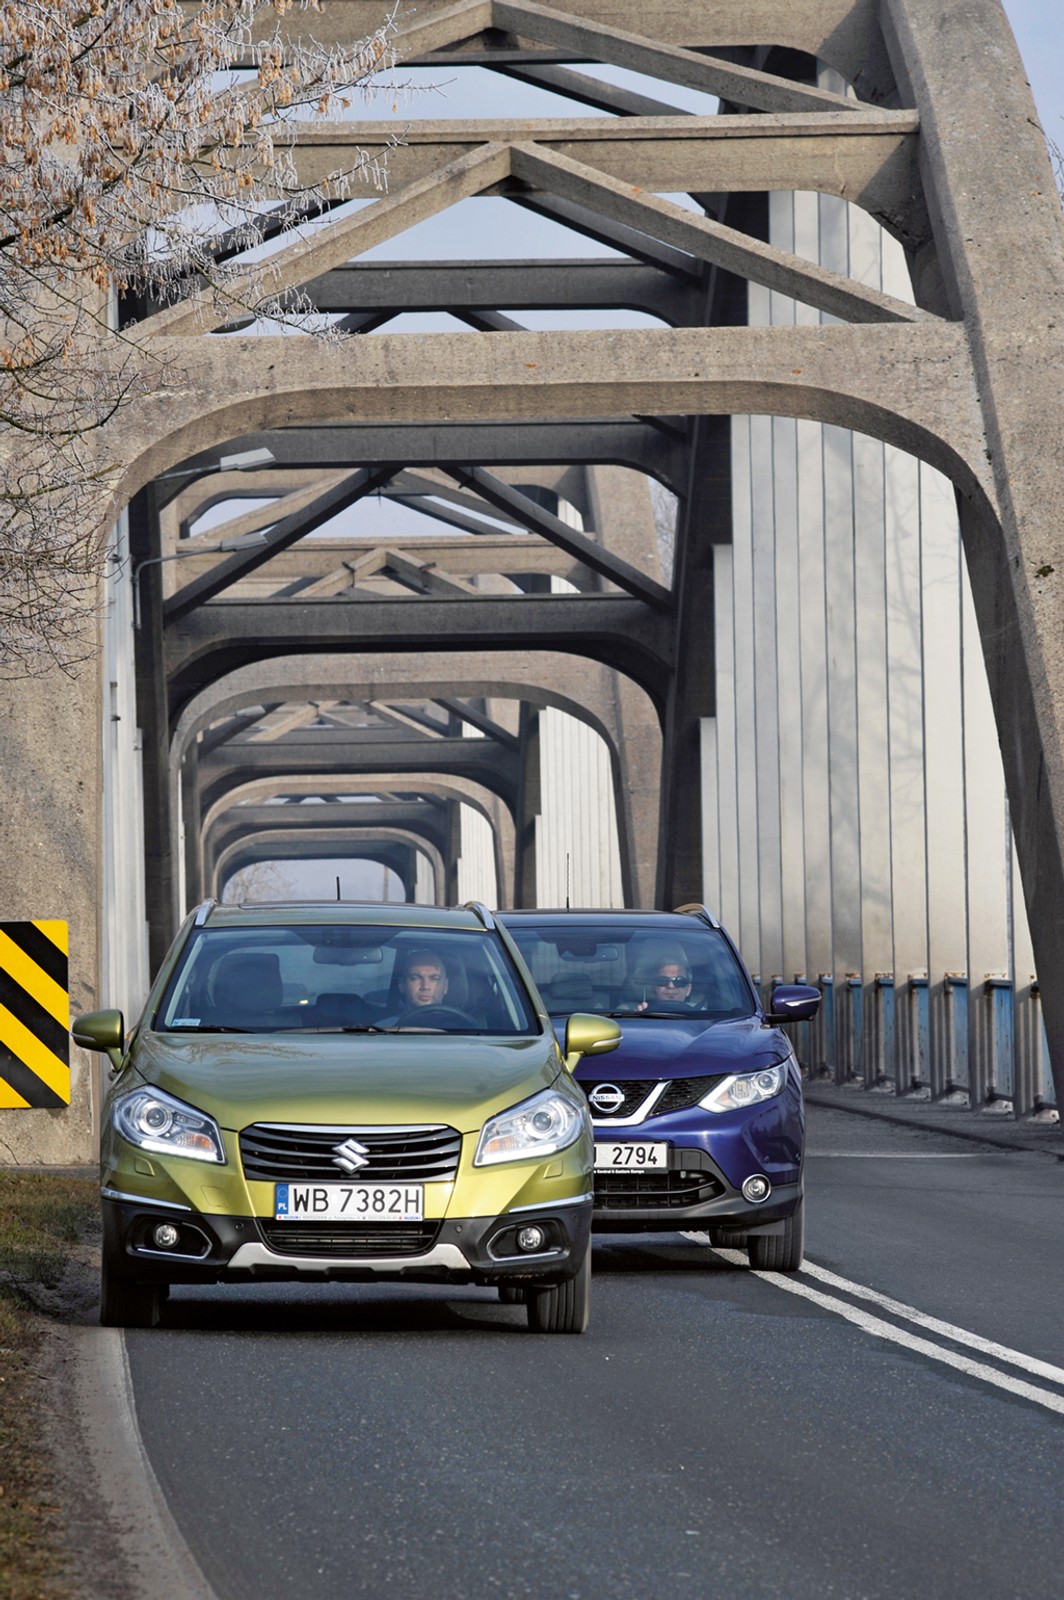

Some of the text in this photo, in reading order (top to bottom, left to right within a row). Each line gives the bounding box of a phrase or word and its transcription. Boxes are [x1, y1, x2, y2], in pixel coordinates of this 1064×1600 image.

[612, 1146, 658, 1165] 2794
[293, 1188, 420, 1213] WB 7382H
